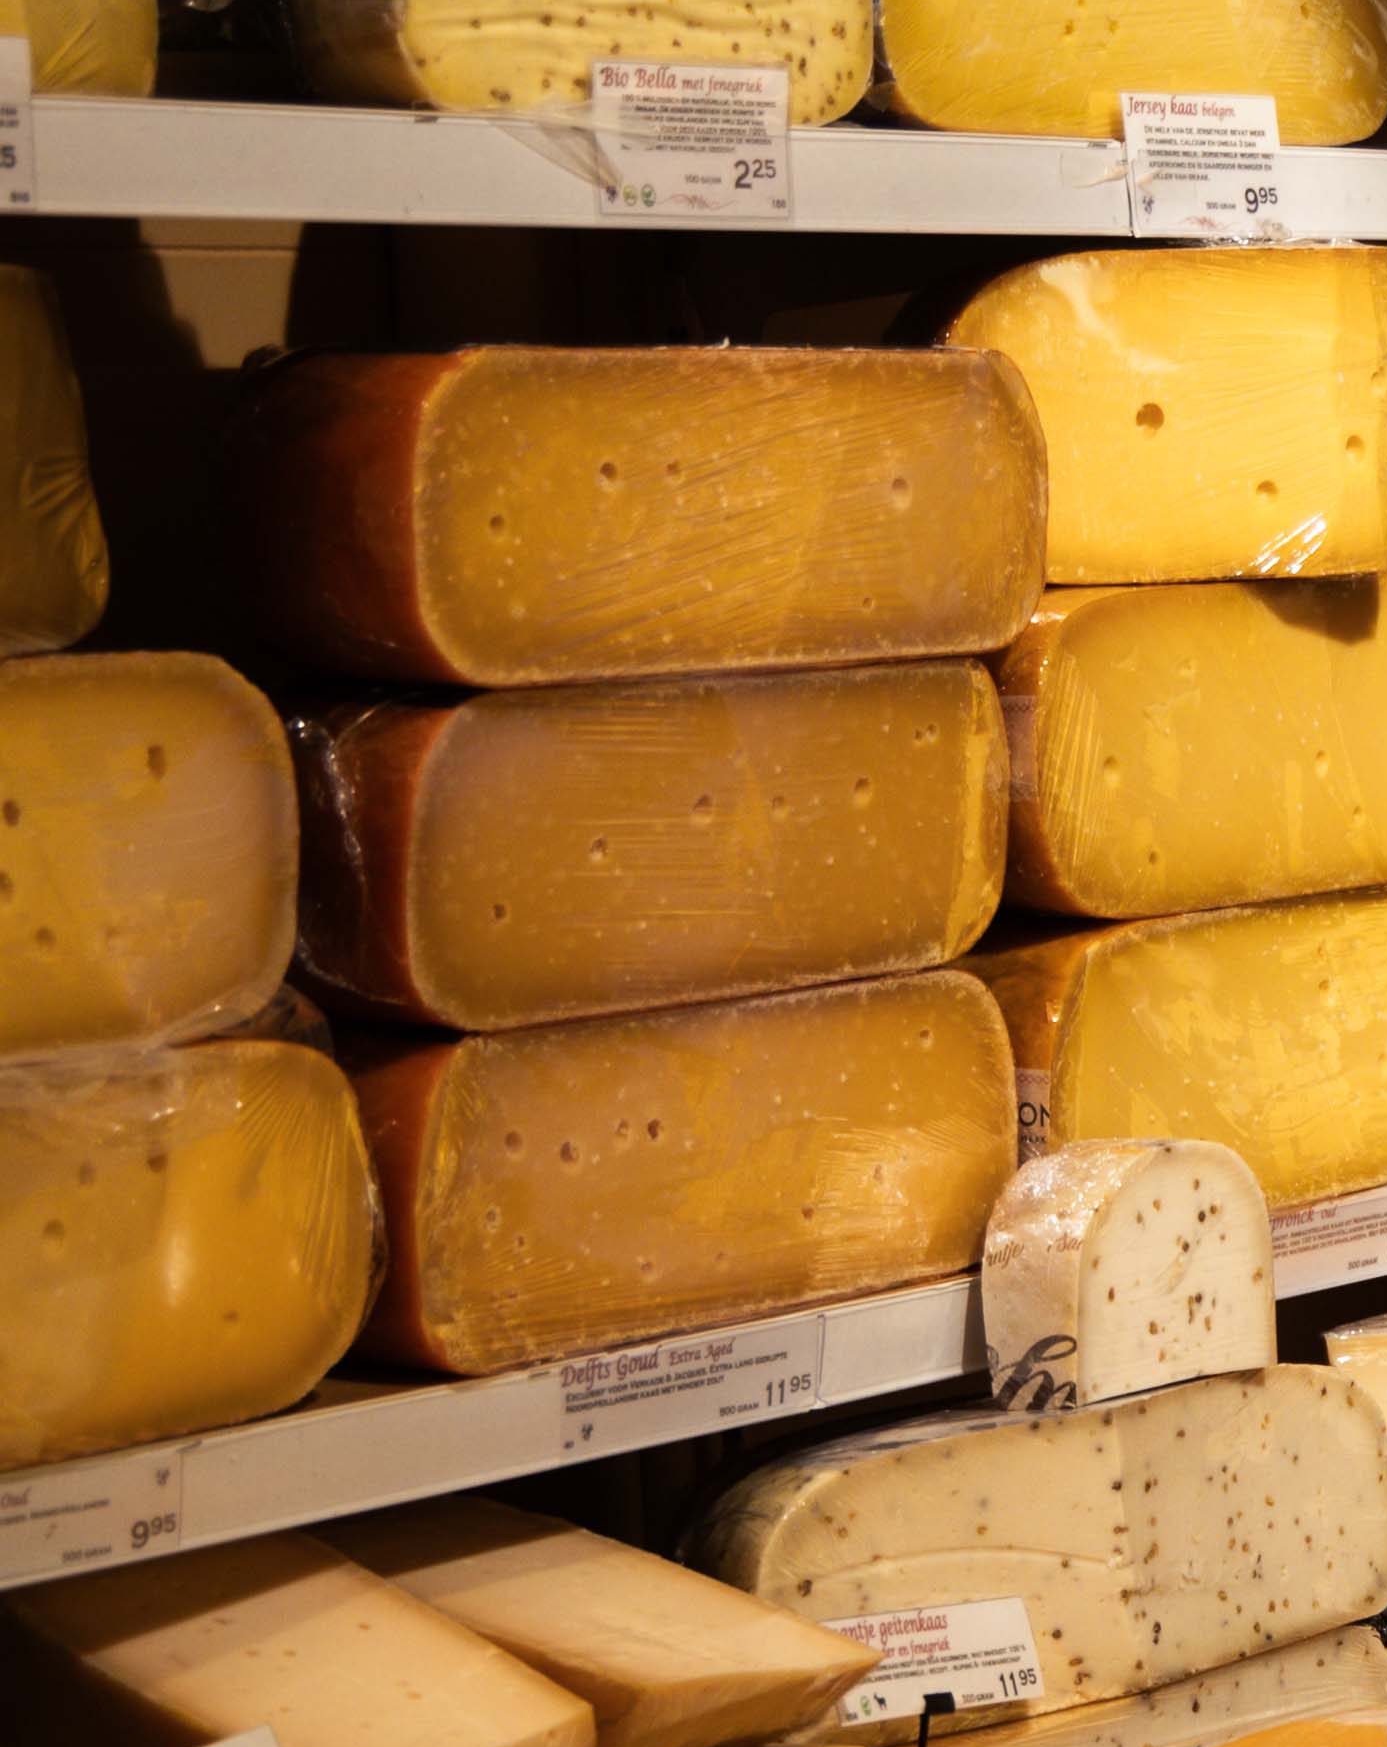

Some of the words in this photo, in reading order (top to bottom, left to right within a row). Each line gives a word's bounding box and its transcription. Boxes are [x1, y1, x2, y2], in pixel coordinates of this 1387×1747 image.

[600, 66, 629, 88] Bio
[635, 66, 677, 89] Bella
[681, 77, 704, 89] met
[708, 76, 763, 96] fenegriek
[1127, 96, 1167, 121] Jersey
[1171, 96, 1199, 117] kaas
[1202, 102, 1235, 122] belegen
[734, 159, 777, 190] 225
[1245, 186, 1279, 214] 995
[561, 1356, 611, 1390] Delfts
[616, 1345, 663, 1381] Goud
[669, 1349, 702, 1367] Extra
[704, 1336, 737, 1362] Aged
[630, 1376, 665, 1391] VERKADE
[709, 1362, 733, 1375] EXTRA
[765, 1373, 812, 1407] 1195
[131, 1513, 177, 1550] 995
[880, 1609, 949, 1645] geitenkaas
[898, 1645, 910, 1656] en
[911, 1637, 951, 1661] fenegriek
[999, 1667, 1038, 1698] 1195
